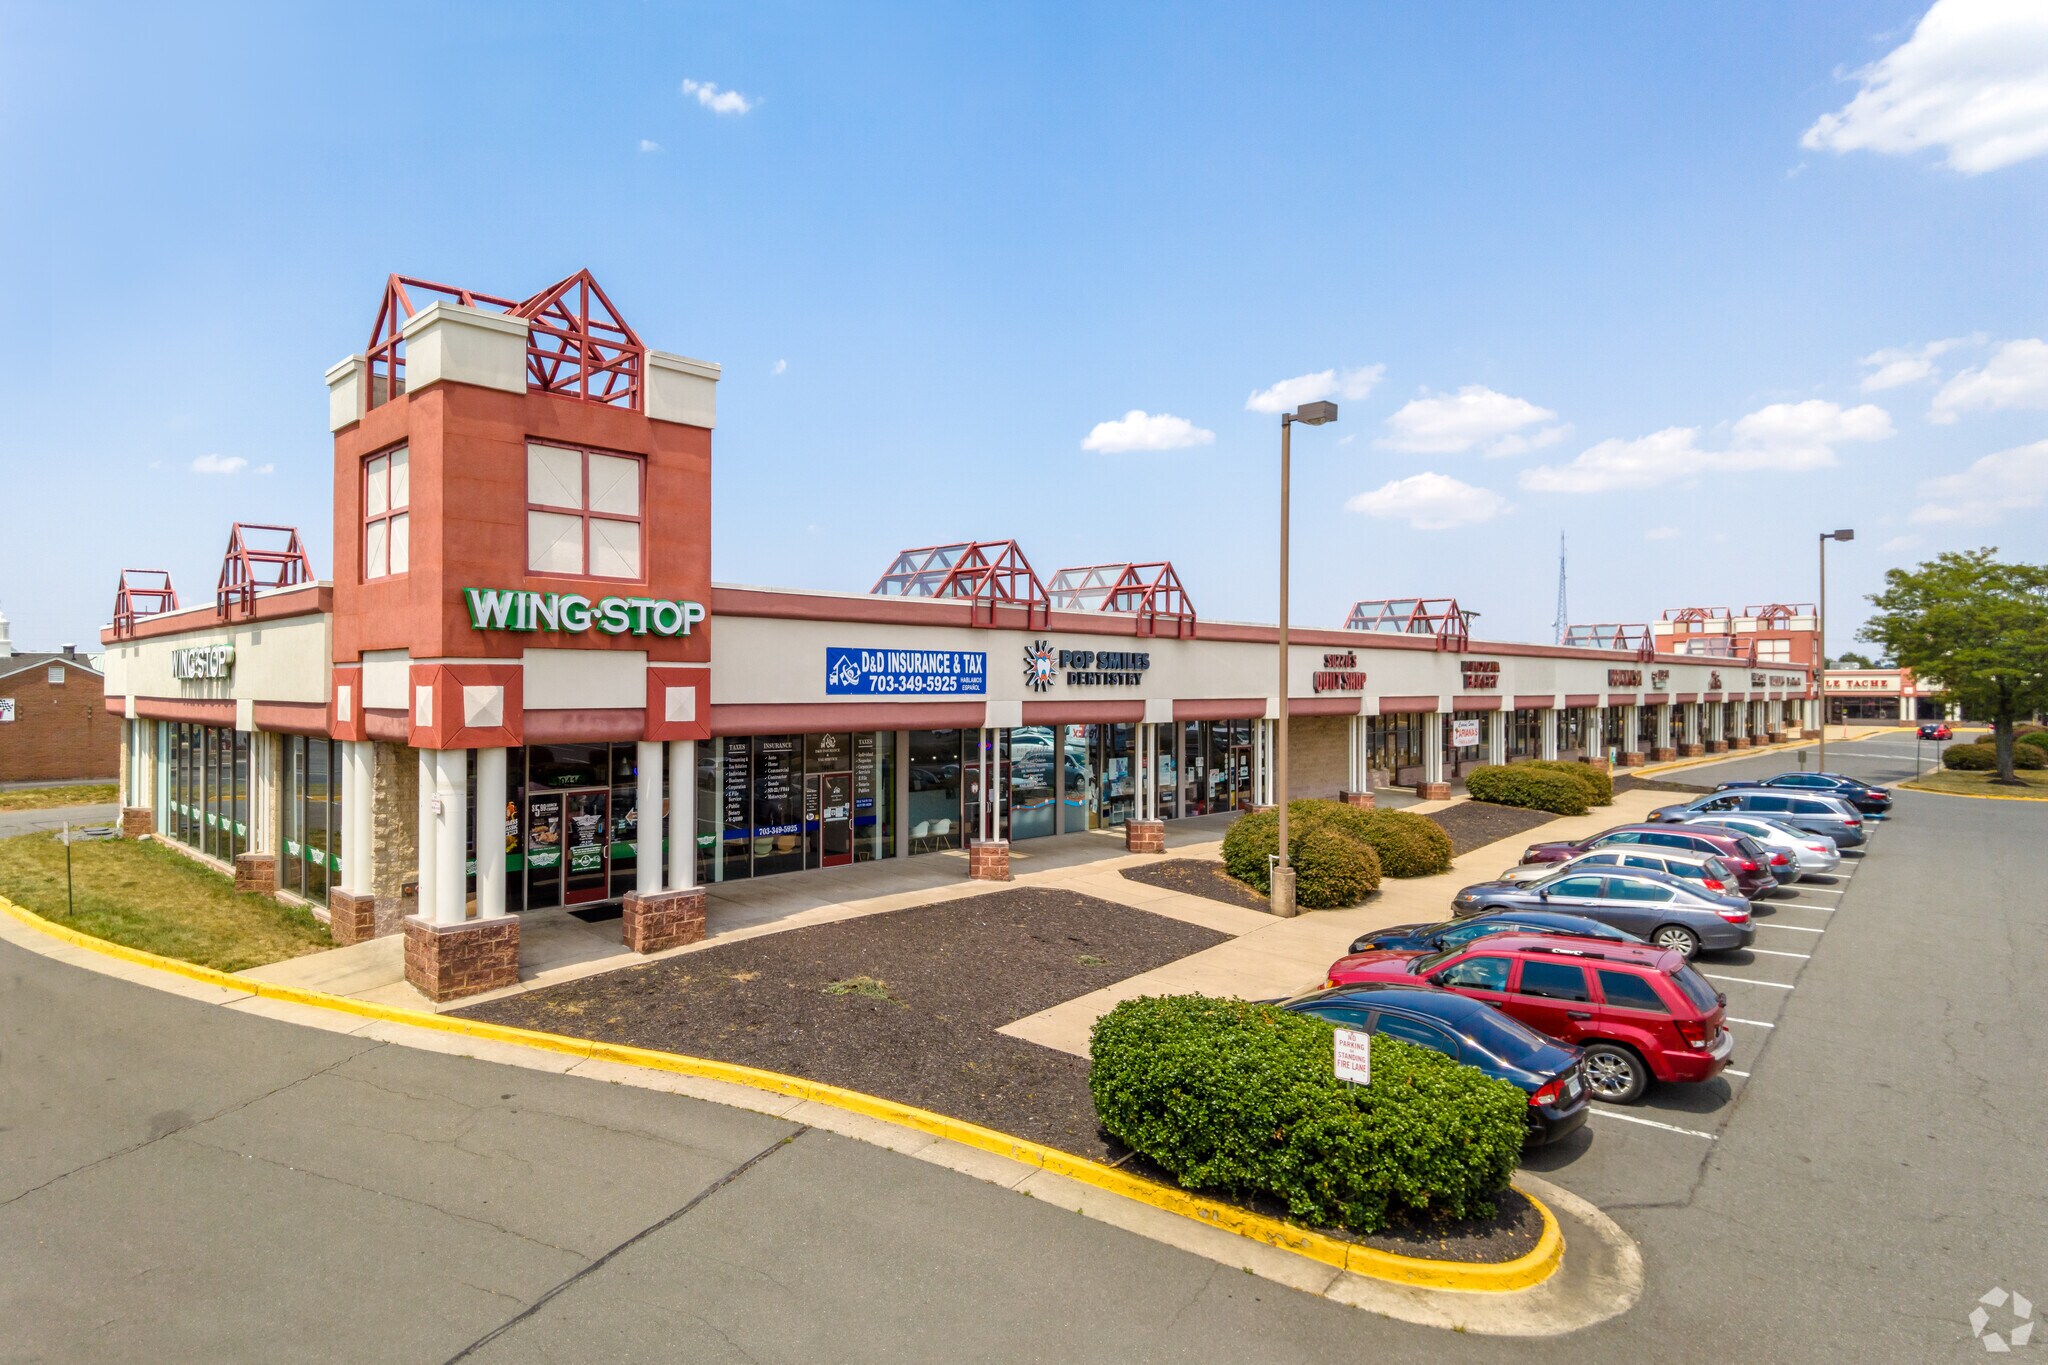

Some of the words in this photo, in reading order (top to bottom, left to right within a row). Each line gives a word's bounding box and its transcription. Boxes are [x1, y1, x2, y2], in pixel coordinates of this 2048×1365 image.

[861, 651, 884, 673] D&D
[888, 652, 950, 674] INSURANCE
[953, 654, 961, 674] &
[964, 654, 983, 674] TAX
[1059, 650, 1095, 668] POP
[1096, 651, 1150, 670] SMILES
[869, 675, 957, 691] 703-349-5925
[1067, 672, 1143, 685] DENTISTRY
[1341, 671, 1366, 690] SHOP
[1826, 680, 1840, 688] LE
[1847, 680, 1888, 688] TACHE
[759, 824, 798, 836] 703-349-5925
[1339, 1039, 1365, 1050] PARKING
[1338, 1051, 1366, 1063] STANDING
[1337, 1059, 1350, 1069] FIRE
[1351, 1062, 1366, 1073] LANE
